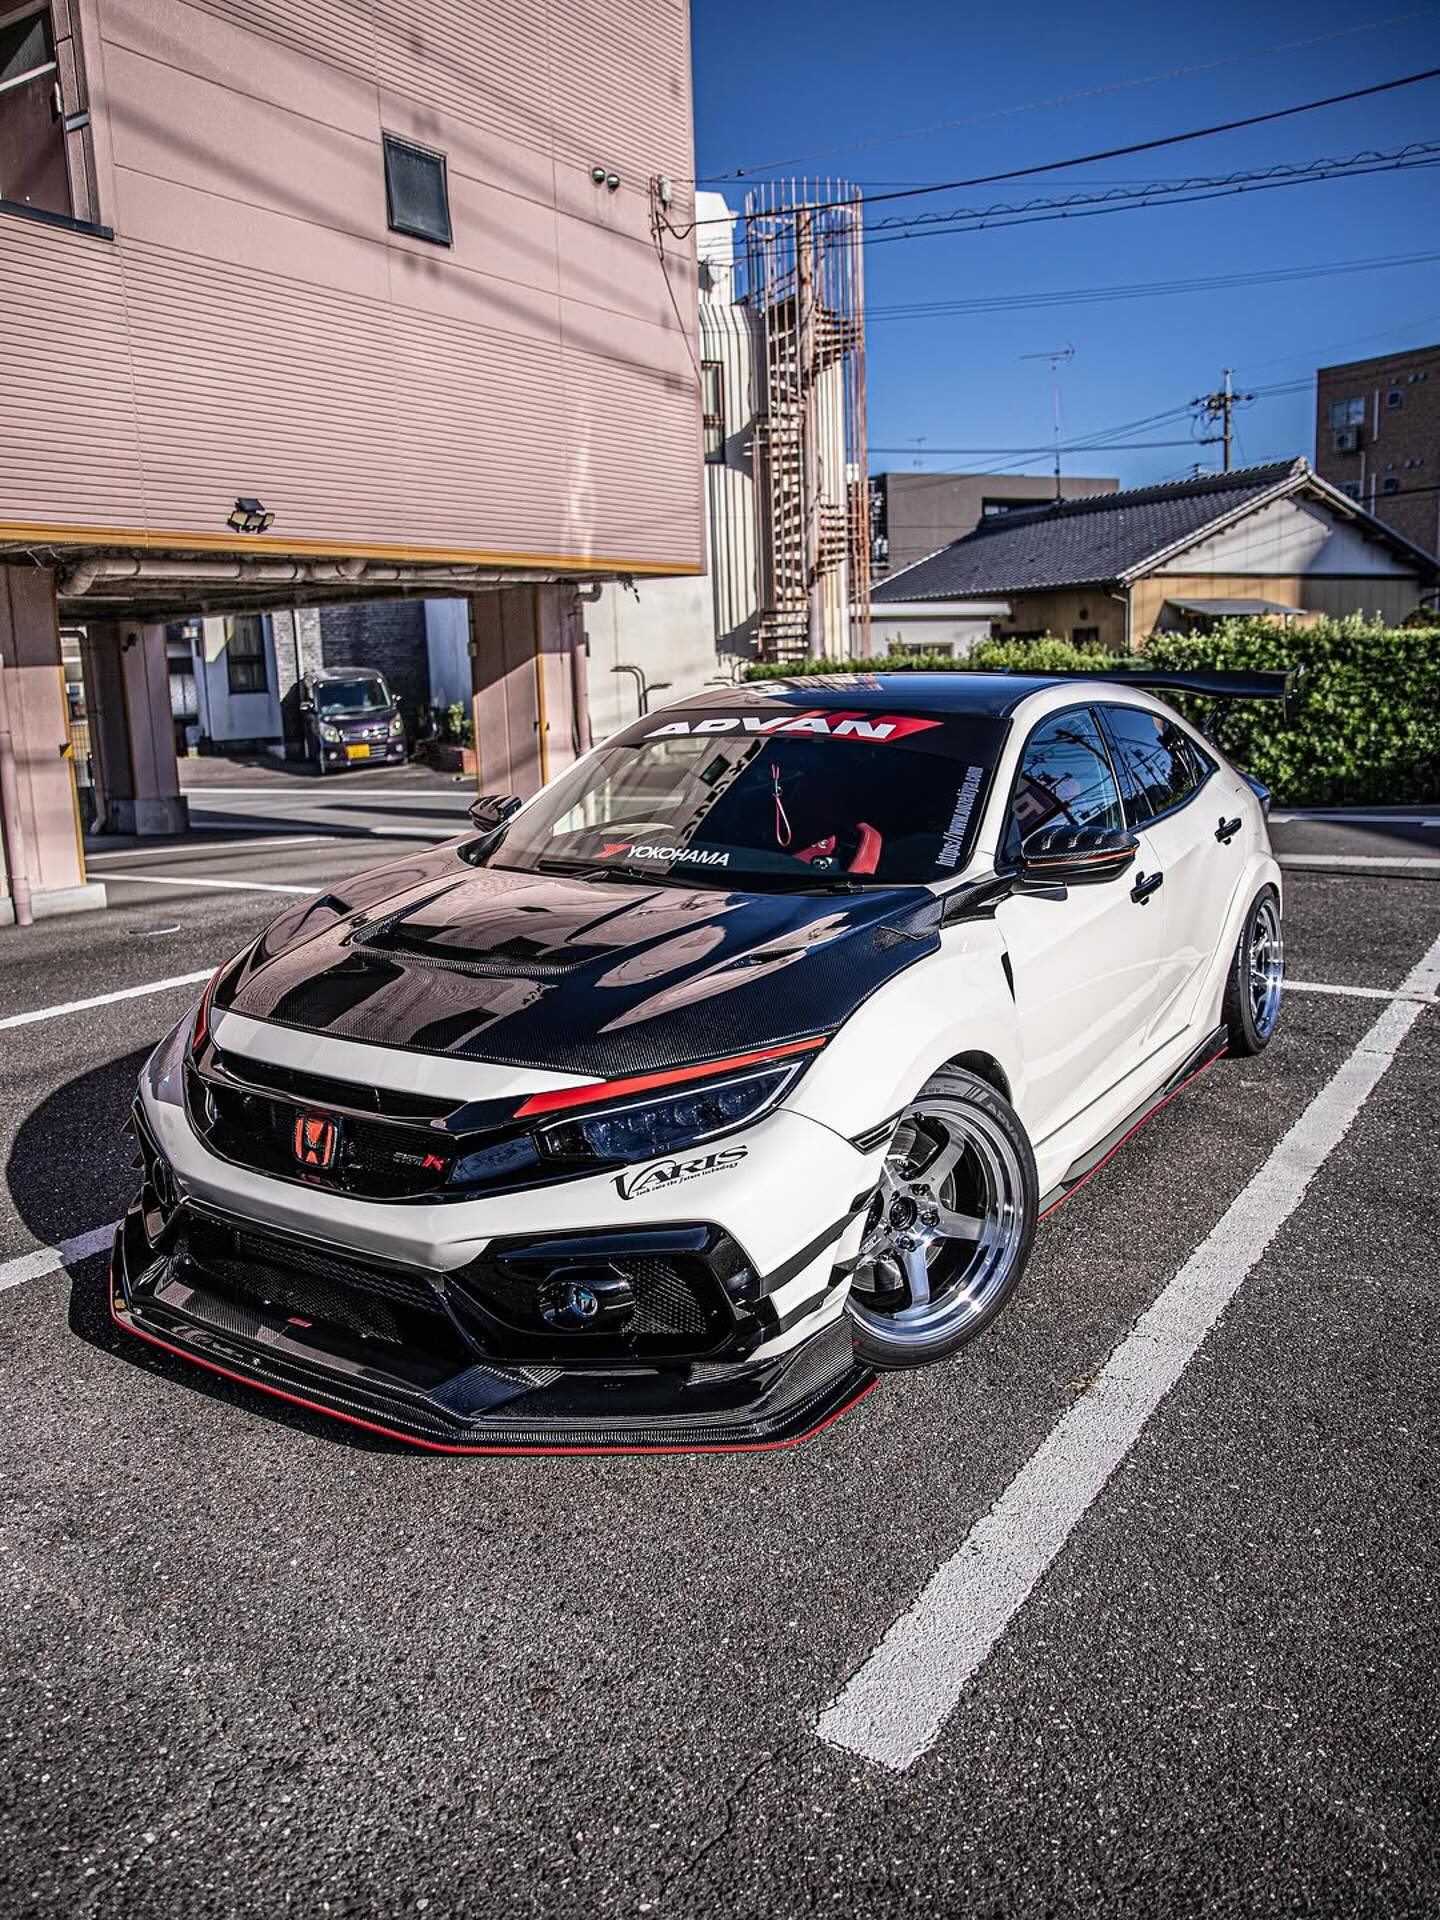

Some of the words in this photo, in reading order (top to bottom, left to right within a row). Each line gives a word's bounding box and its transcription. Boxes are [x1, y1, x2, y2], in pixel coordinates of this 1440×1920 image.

[643, 717, 896, 740] ADVAN
[627, 845, 730, 867] YOKOHAMA
[610, 1144, 749, 1201] VARIS
